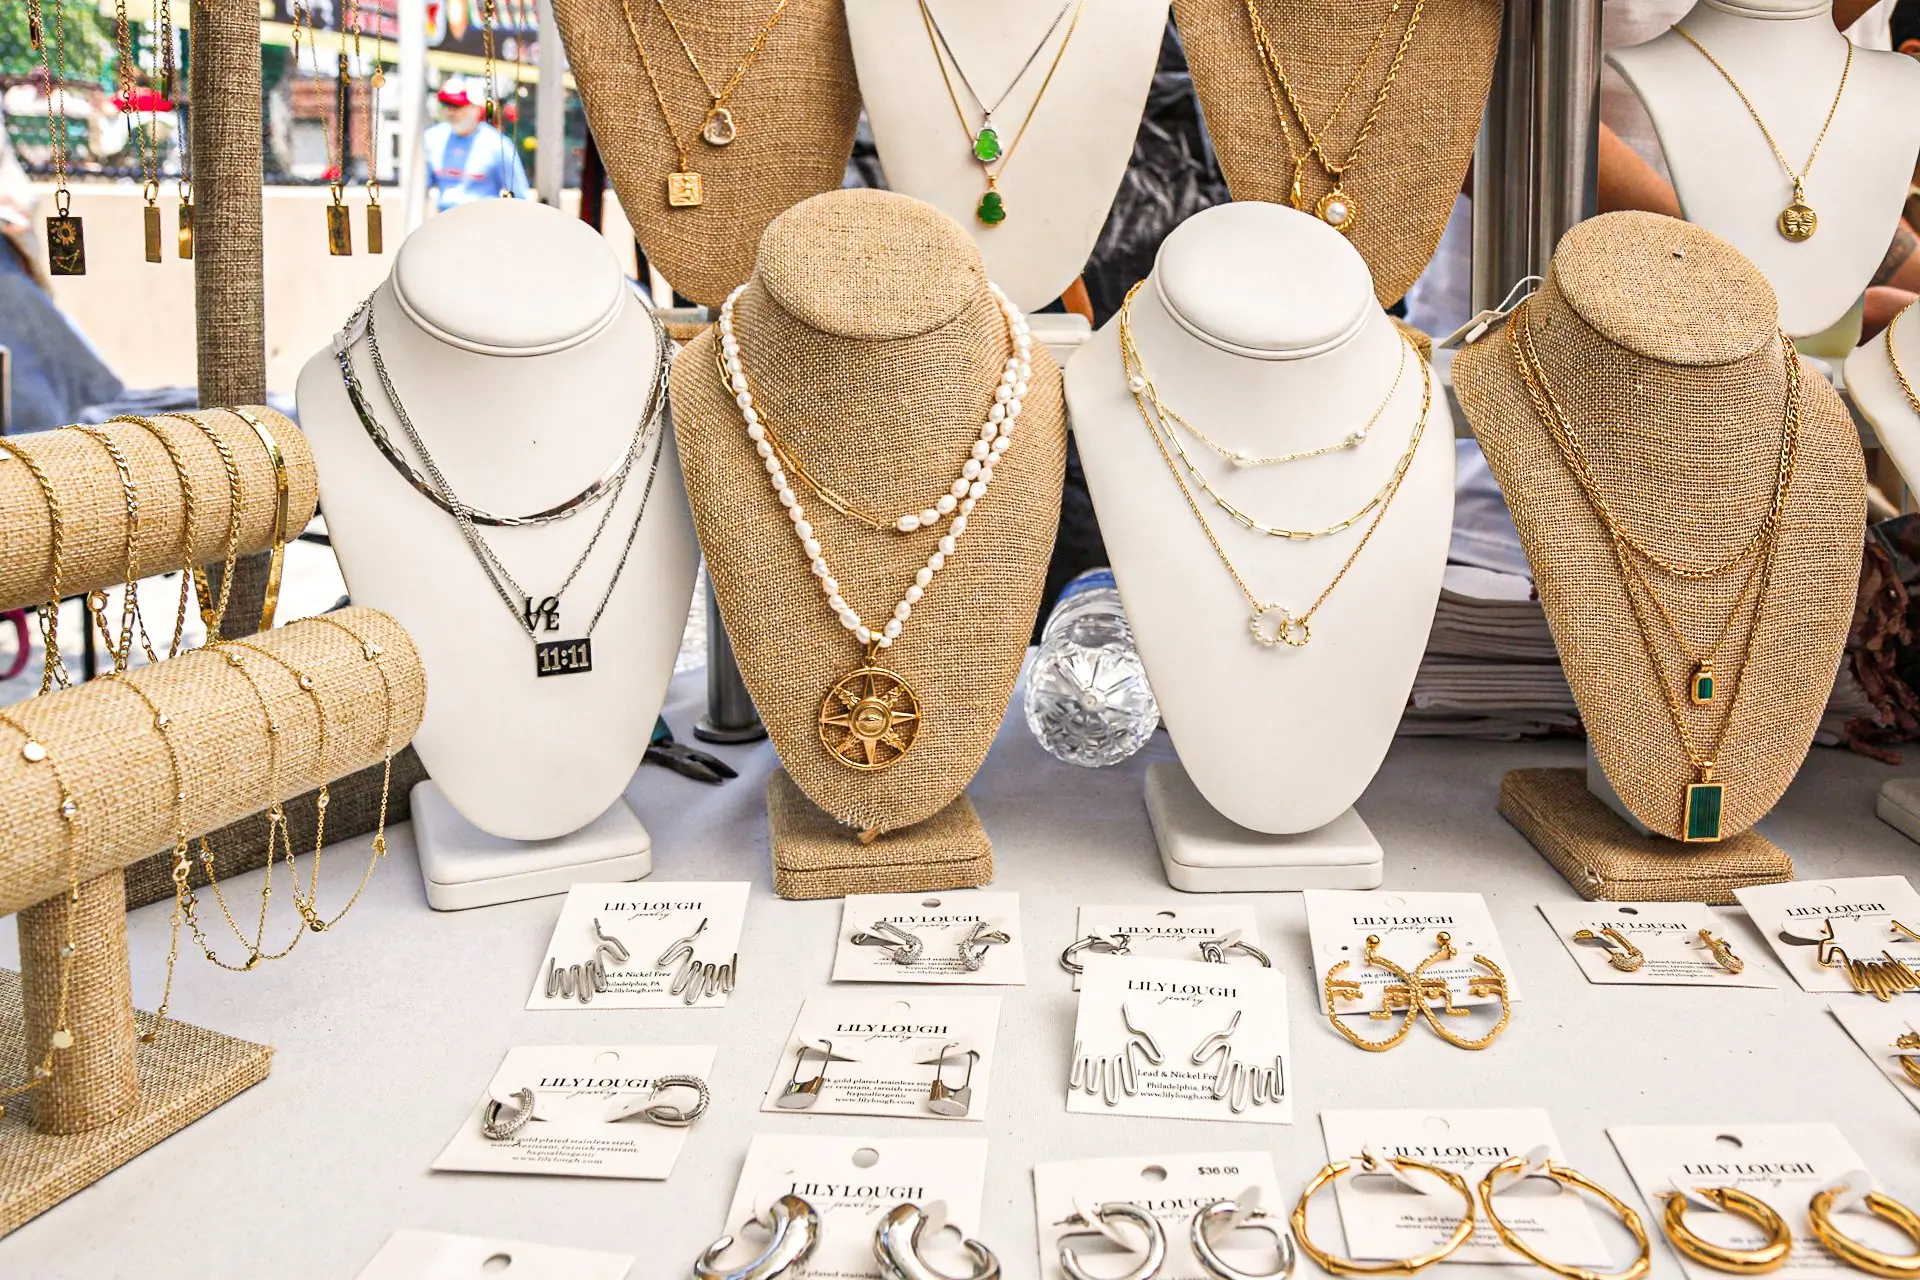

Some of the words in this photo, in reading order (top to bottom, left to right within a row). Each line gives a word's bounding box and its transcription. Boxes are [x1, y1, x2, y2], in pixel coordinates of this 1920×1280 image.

[539, 643, 589, 672] 11:11
[604, 902, 643, 911] LILY
[643, 902, 702, 911] LOUGH
[1786, 907, 1823, 917] LILY
[1824, 903, 1886, 913] LOUGH
[1352, 917, 1390, 926] LILY
[1393, 916, 1454, 925] LOUGH
[1629, 922, 1687, 930] LOUGH
[1118, 926, 1154, 934] LILY
[1157, 927, 1215, 935] LOUGH
[1128, 980, 1169, 992] LILY
[1172, 983, 1237, 998] LOUGH
[836, 1024, 880, 1033] LILY
[881, 1025, 948, 1034] LOUGH
[1138, 1069, 1159, 1077] Lead
[1171, 1071, 1200, 1080] Nickel
[540, 1078, 584, 1087] LILY
[1433, 1146, 1510, 1156] LOUGH
[1197, 1166, 1239, 1176] $36.00
[1683, 1164, 1732, 1175] LILY
[1736, 1163, 1816, 1175] LOUGH
[789, 1182, 841, 1197] LILY
[843, 1184, 924, 1200] LOUGH
